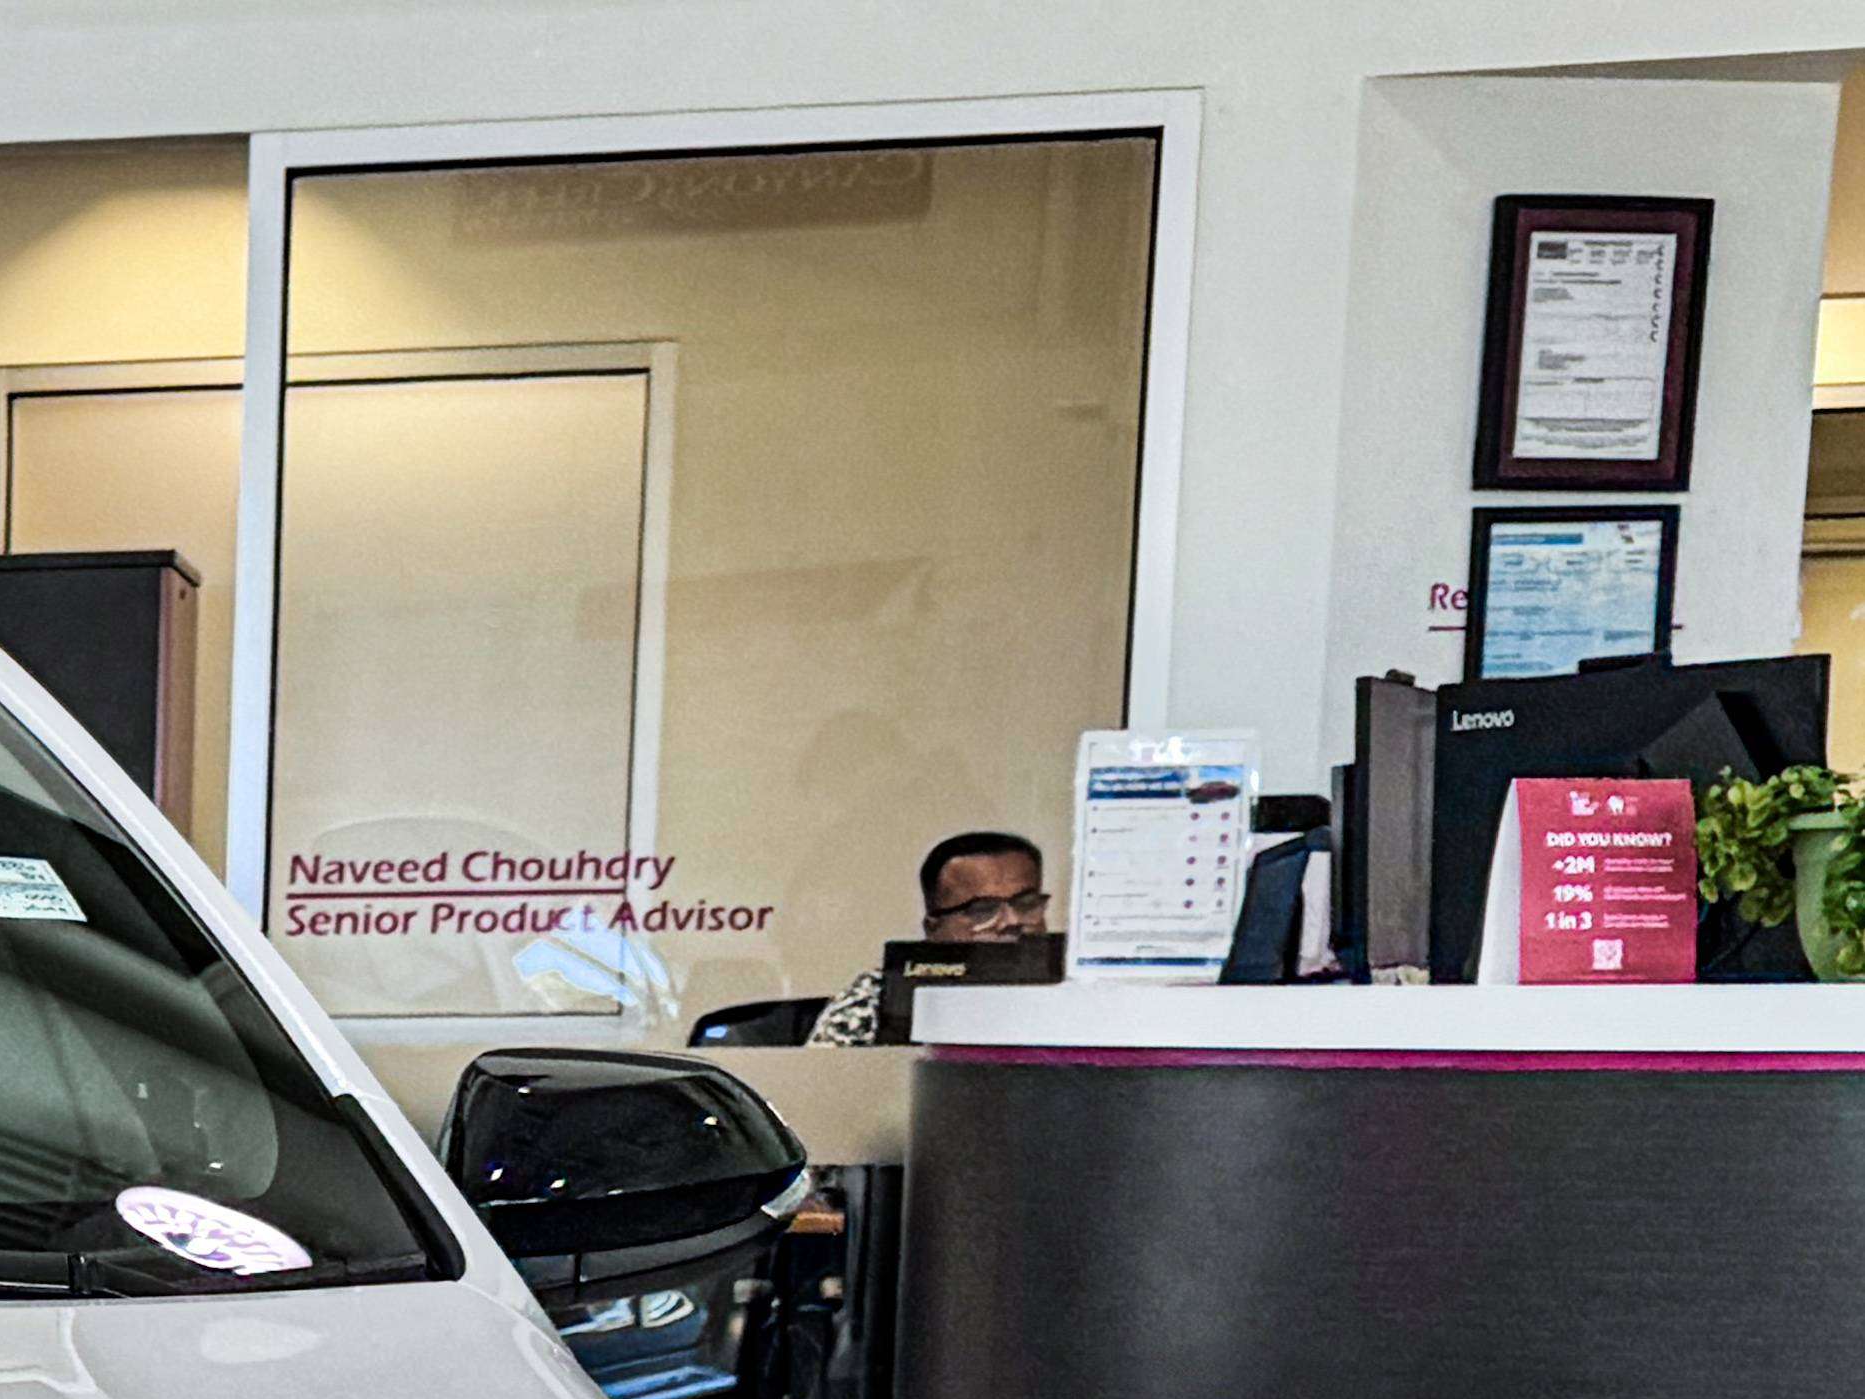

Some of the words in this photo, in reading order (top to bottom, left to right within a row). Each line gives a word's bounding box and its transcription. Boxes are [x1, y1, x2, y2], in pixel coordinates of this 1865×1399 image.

[1451, 709, 1515, 732] Lenovo
[1546, 831, 1576, 847] DID
[1577, 832, 1611, 847] YOU
[288, 851, 448, 886] Naveed
[461, 850, 676, 890] Chouhdry
[1552, 884, 1594, 902] 19%
[285, 903, 416, 937] Senior
[430, 902, 595, 936] Product
[608, 900, 775, 933] Advisor
[1544, 912, 1556, 929] 1
[1557, 911, 1577, 930] in
[1579, 911, 1593, 930] 3
